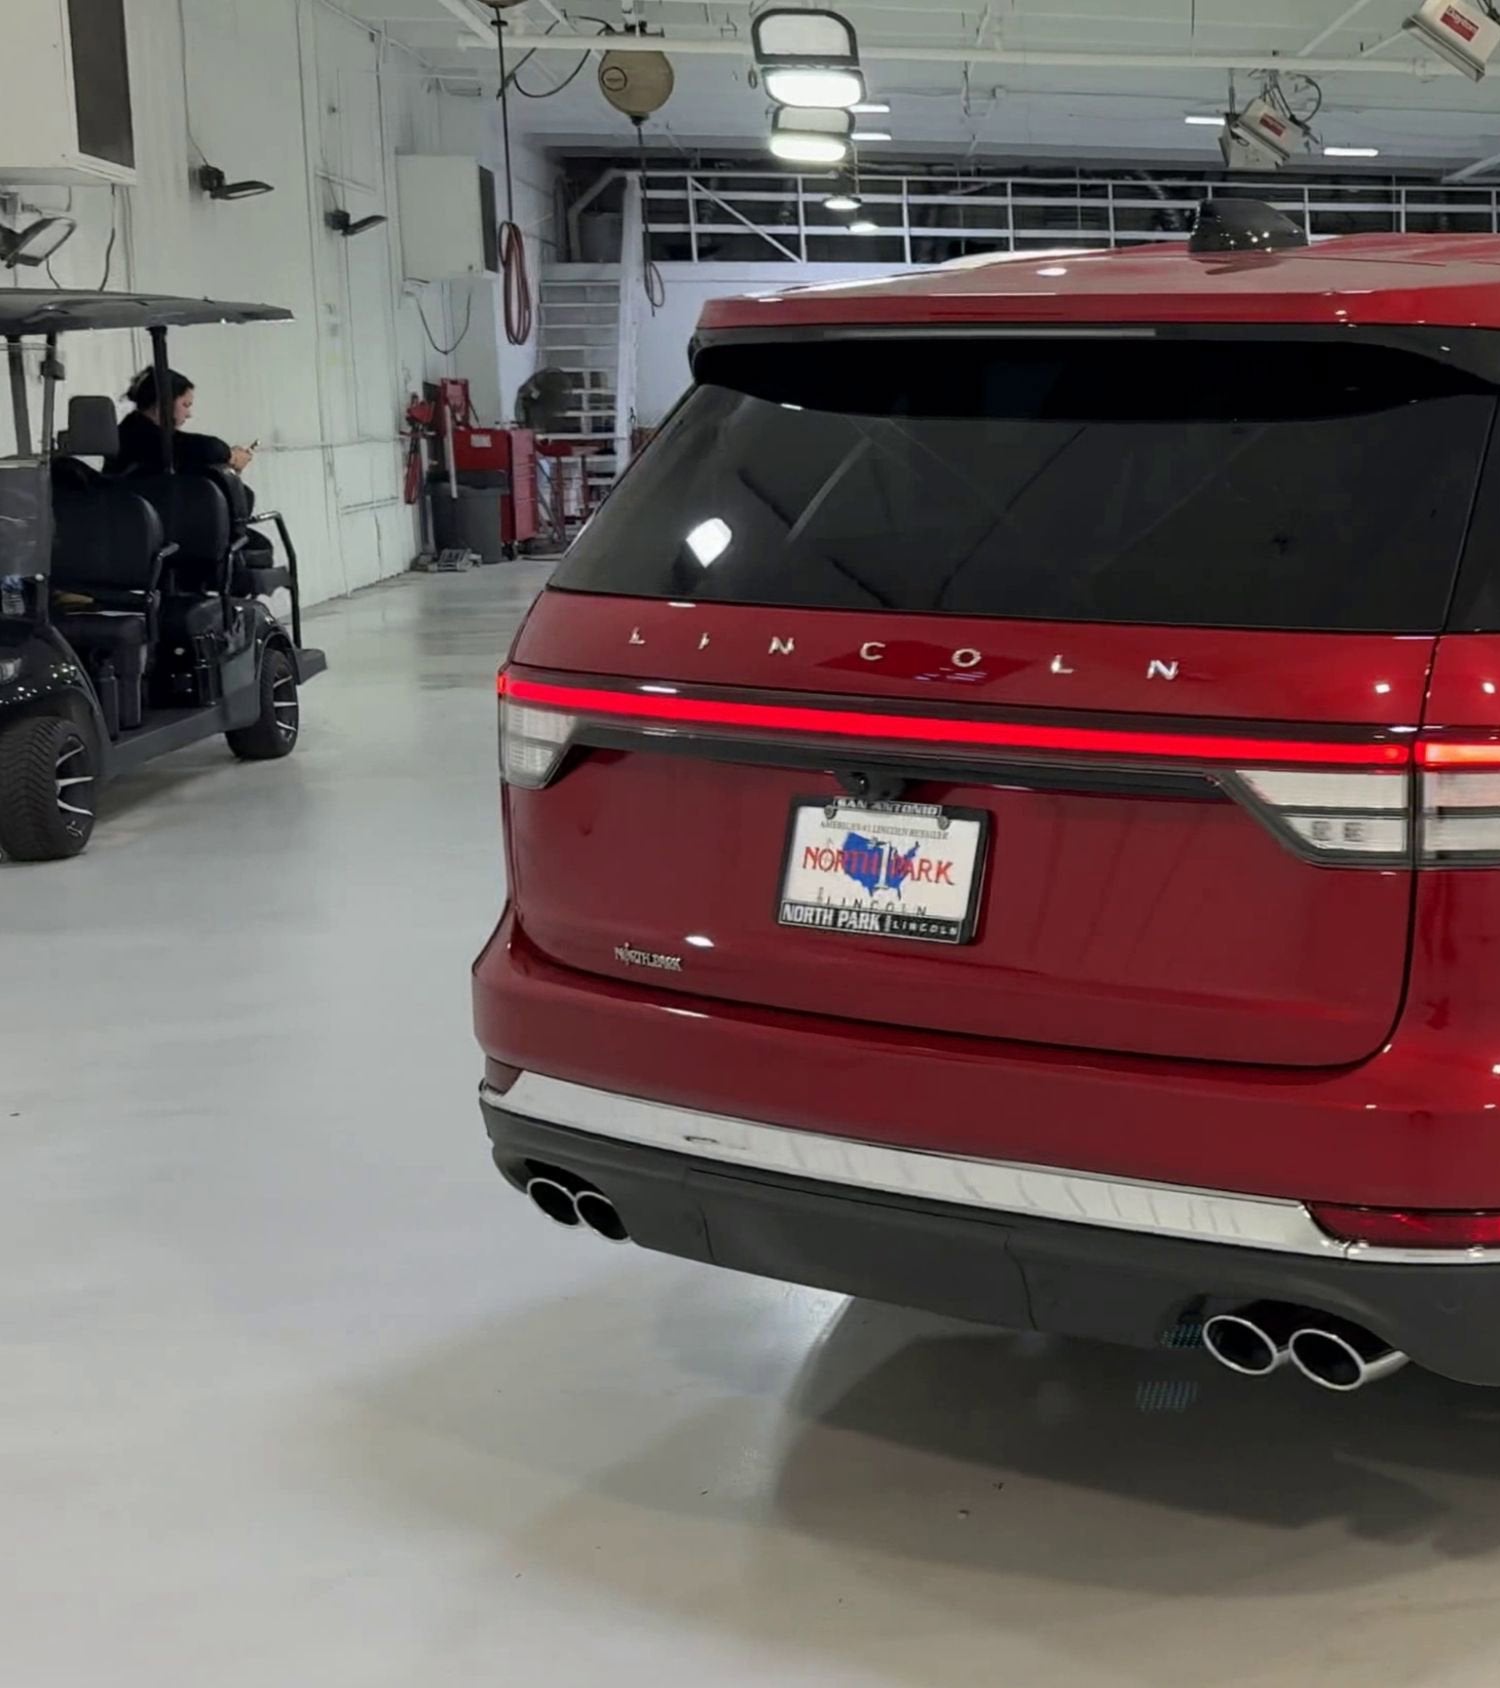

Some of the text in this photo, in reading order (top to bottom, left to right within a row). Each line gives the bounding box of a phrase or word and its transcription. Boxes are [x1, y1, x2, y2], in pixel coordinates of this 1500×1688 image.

[628, 626, 1179, 681] LINCOLN
[837, 798, 939, 815] SAN ANTONIO
[803, 846, 955, 885] NORTH PARK
[782, 904, 957, 936] NORTH PARK LINCOLN
[826, 895, 927, 917] LINCOLN
